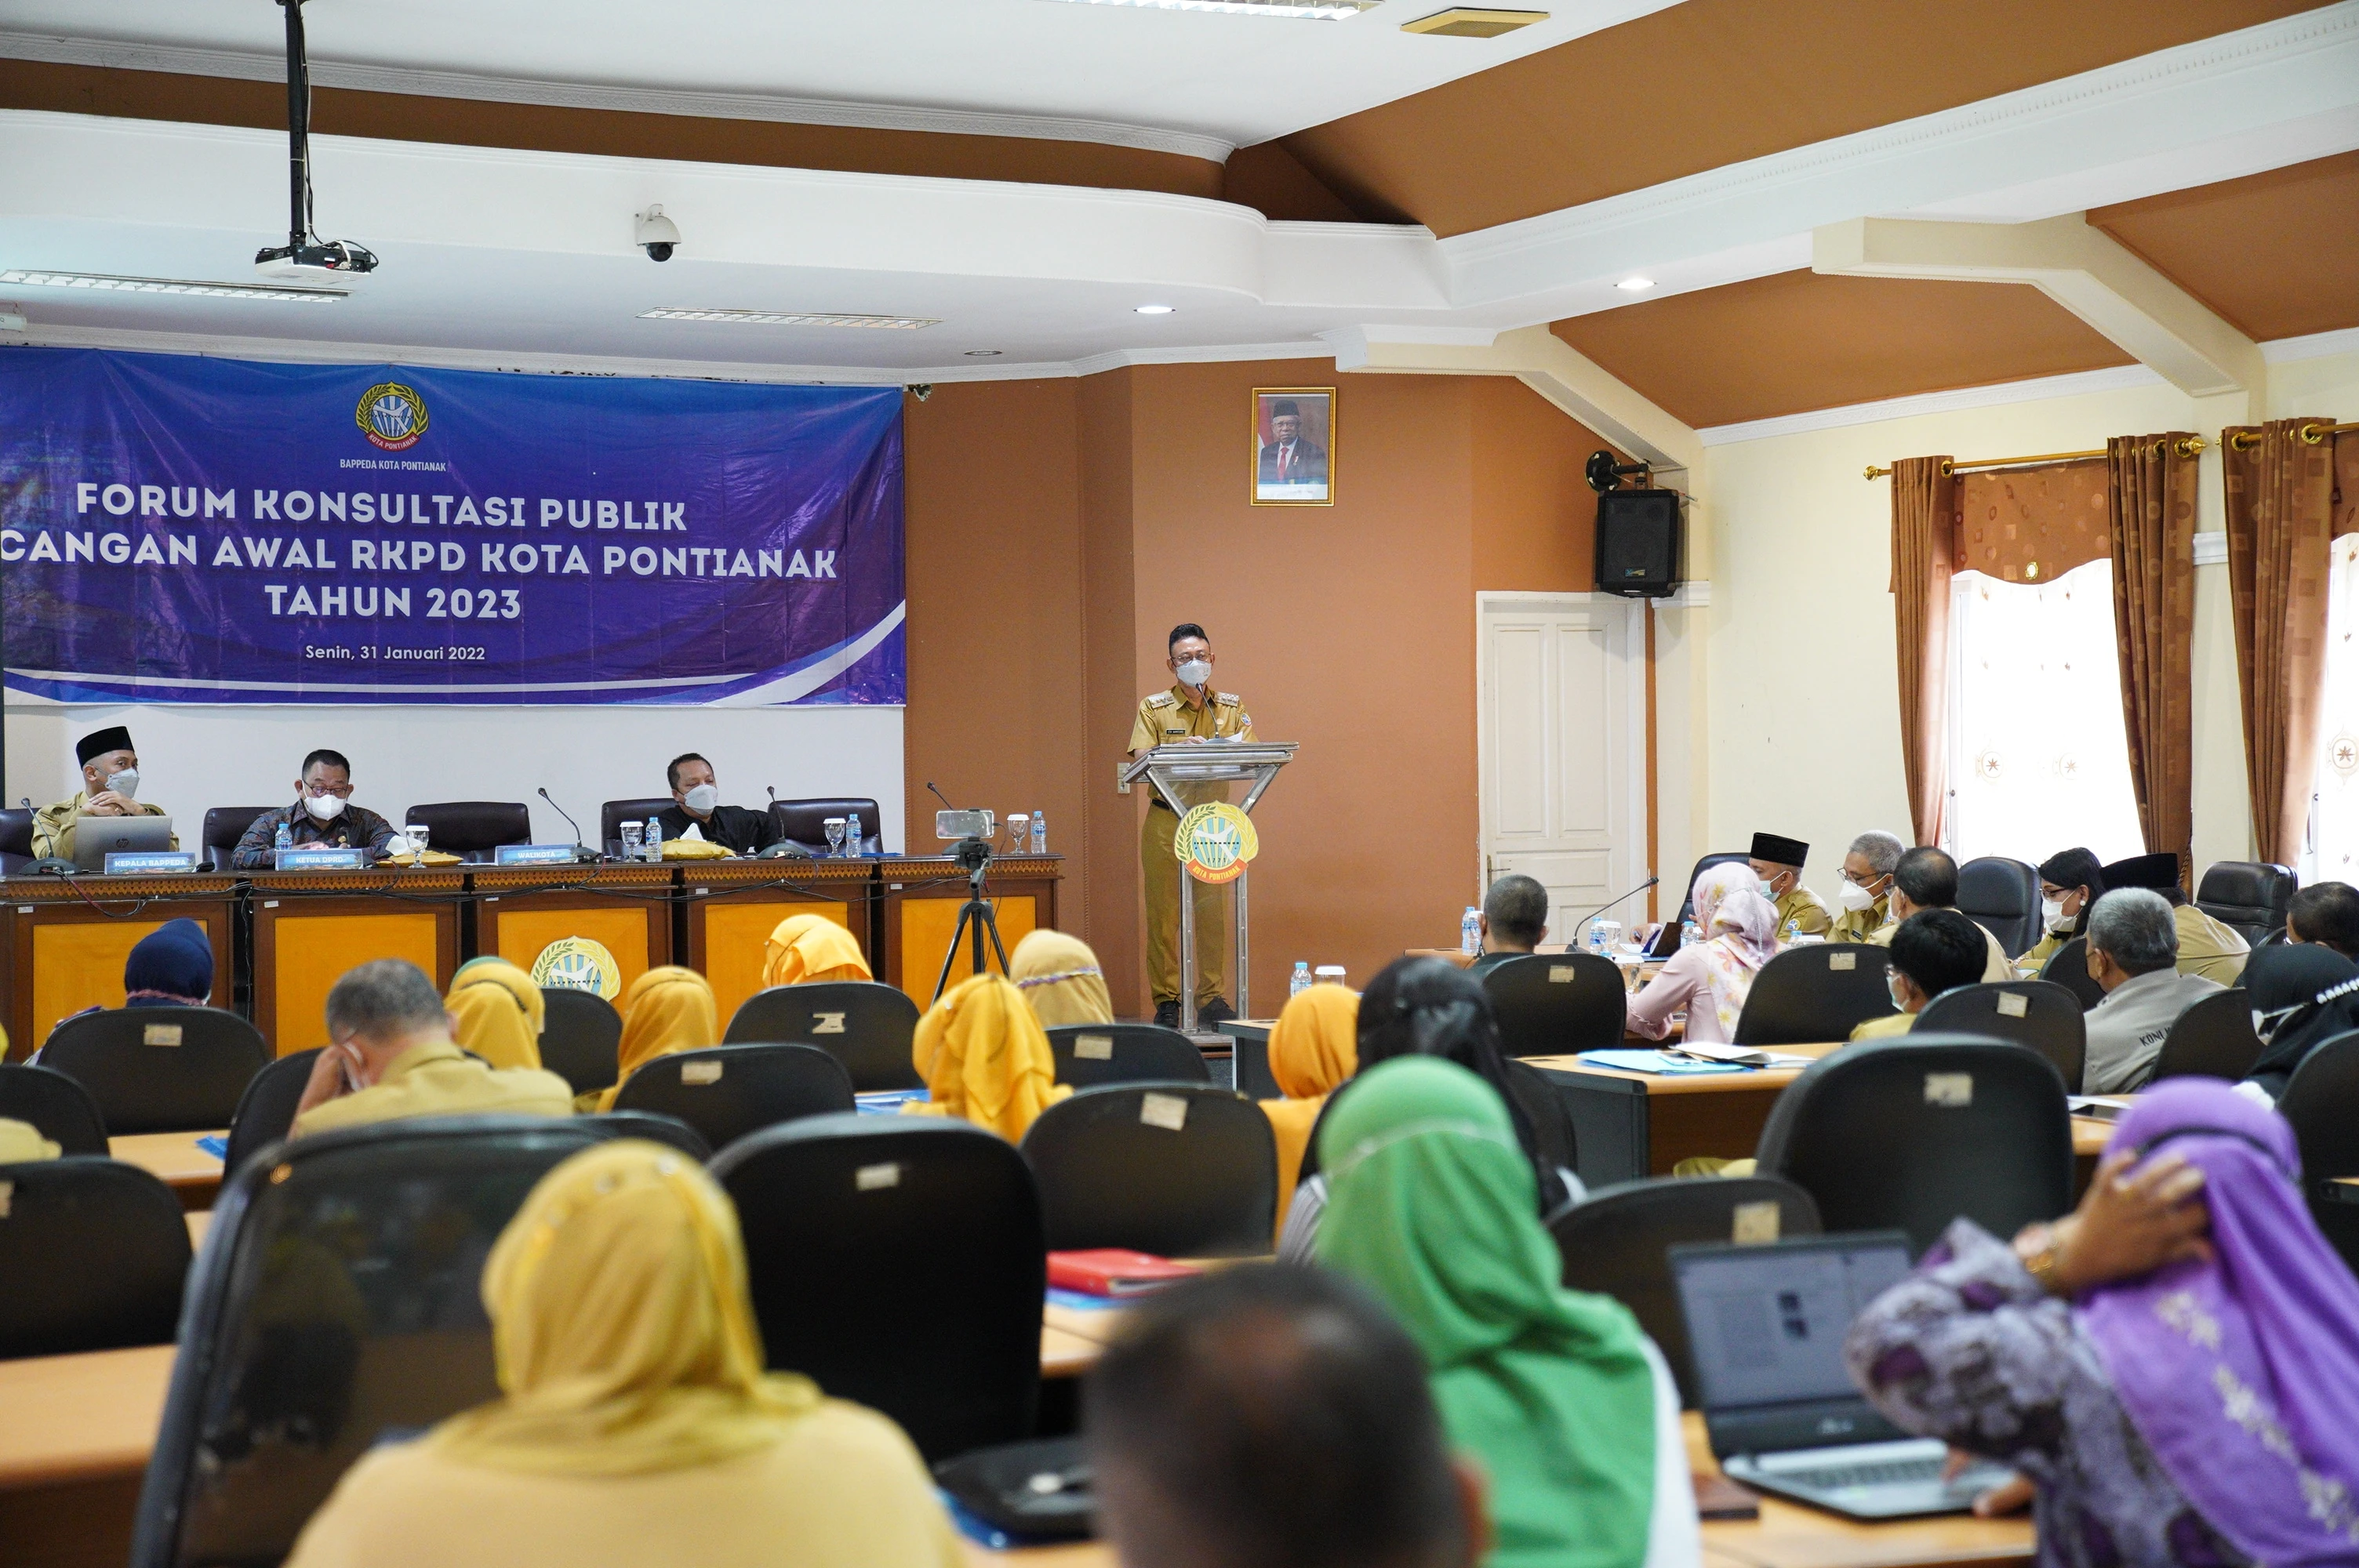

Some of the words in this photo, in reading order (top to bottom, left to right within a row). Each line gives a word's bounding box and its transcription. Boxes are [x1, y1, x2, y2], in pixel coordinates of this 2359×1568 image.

[368, 434, 383, 447] KOTA
[384, 436, 417, 450] PONTIANAK
[340, 459, 376, 470] BAPPEDA
[378, 460, 400, 470] KOTA
[402, 461, 446, 472] PONTIANAK
[77, 482, 236, 519] FORUM
[254, 489, 526, 527] KONSULTASI
[540, 499, 687, 531] PUBLIK
[1, 529, 198, 565] CANGAN
[212, 536, 336, 568] AWAL
[351, 539, 467, 572] RKPD
[482, 543, 590, 574] KOTA
[604, 546, 837, 579] PONTIANAK
[264, 585, 411, 617] TAHUN
[426, 588, 522, 619] 2023
[305, 644, 356, 661] Senin,
[360, 645, 377, 660] 31
[383, 646, 444, 660] Januari
[448, 646, 485, 660] 2022
[1193, 866, 1207, 878] KOTA
[1209, 866, 1241, 880] PONTIANAK
